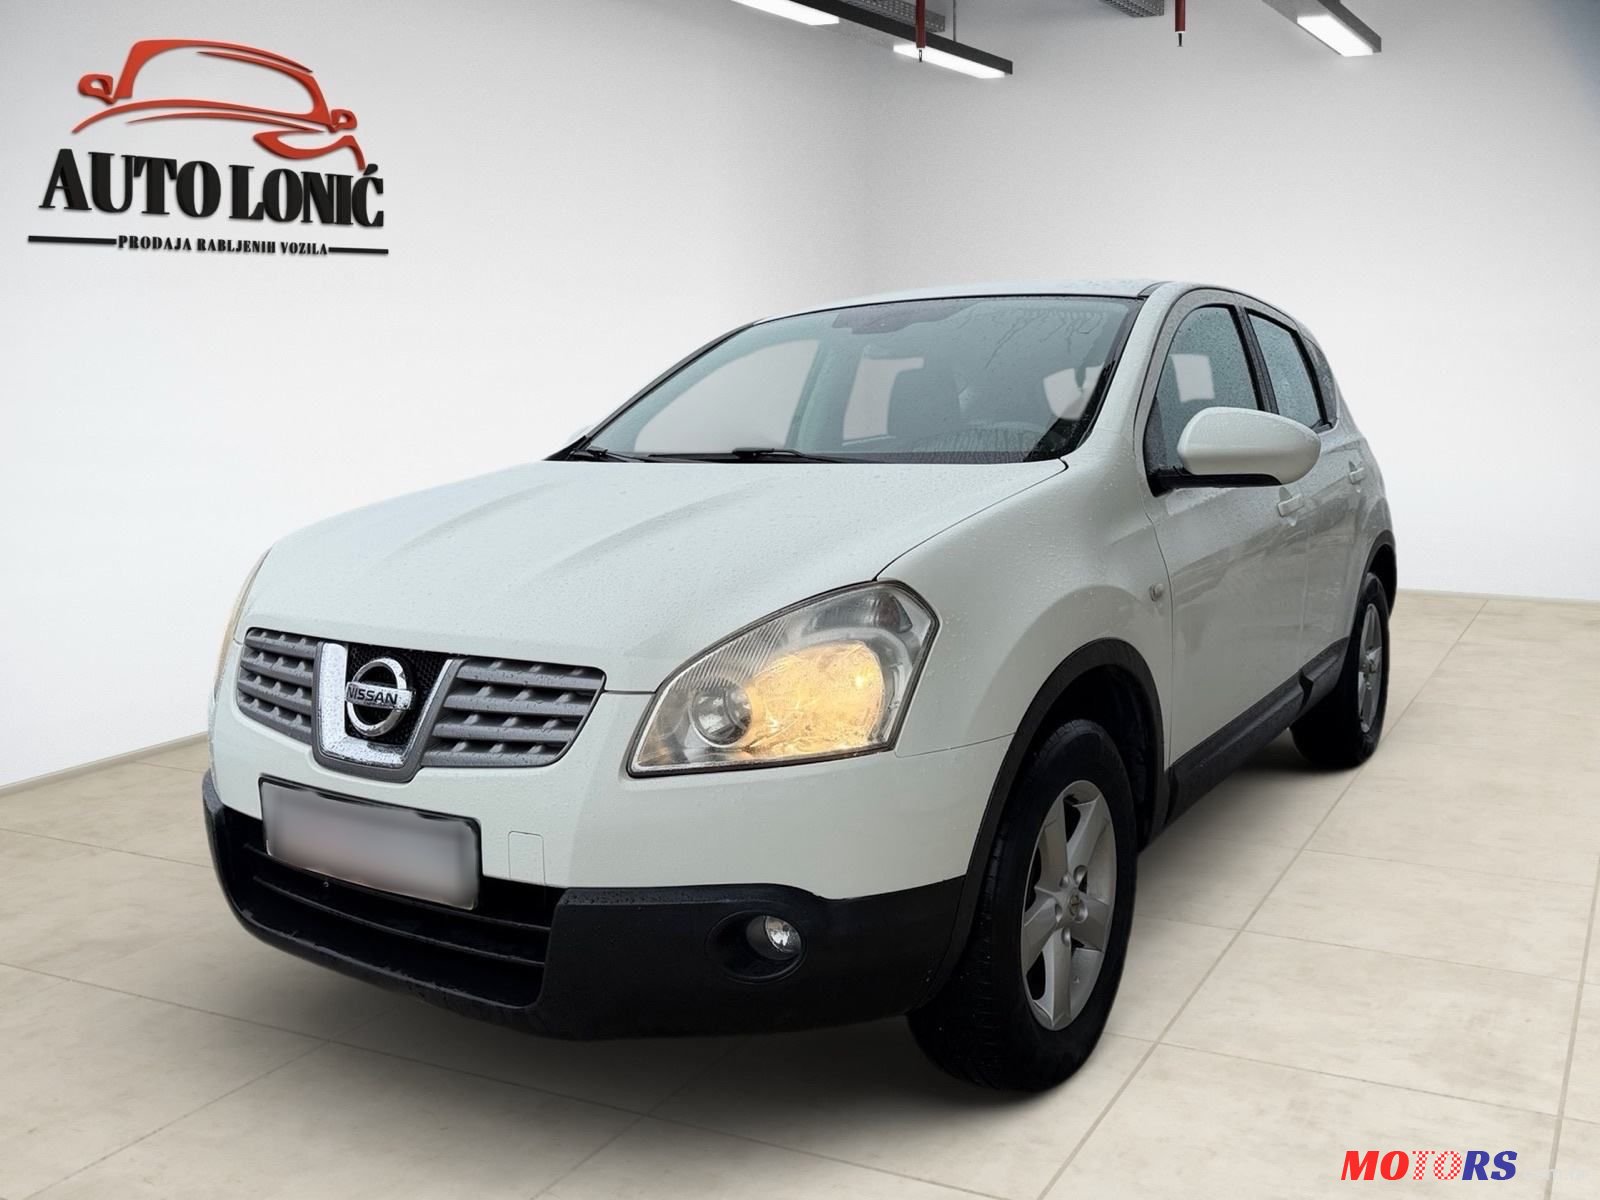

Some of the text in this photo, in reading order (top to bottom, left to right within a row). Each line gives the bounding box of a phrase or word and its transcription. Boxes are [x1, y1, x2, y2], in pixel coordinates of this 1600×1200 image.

[39, 149, 384, 227] AUTO LONIĆ
[118, 235, 328, 255] PRODAJA RABLJENIH VOZILA
[347, 687, 398, 704] NISSAN
